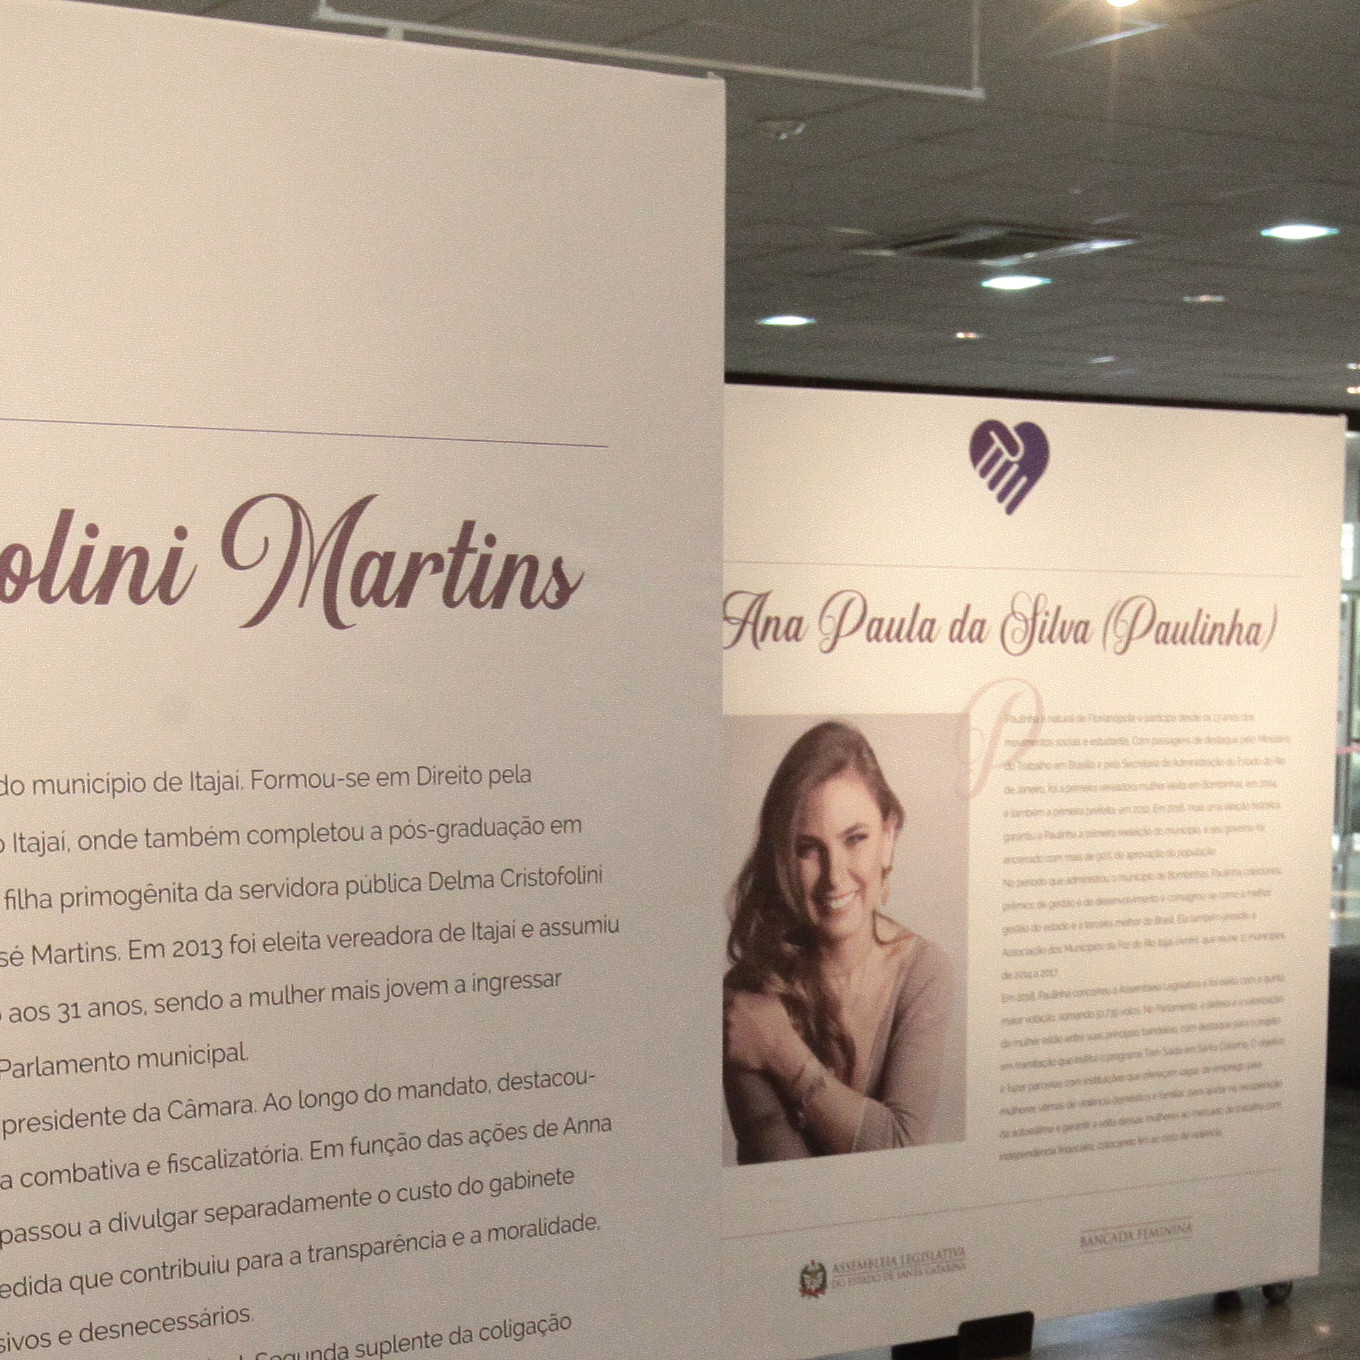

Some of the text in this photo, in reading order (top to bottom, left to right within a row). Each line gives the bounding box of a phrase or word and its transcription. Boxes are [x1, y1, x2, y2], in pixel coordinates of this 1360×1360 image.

[219, 492, 586, 631] Martins
[723, 589, 1279, 657] Ana Paula da Silva (Paulinha)
[31, 772, 147, 800] município
[151, 769, 183, 793] de
[188, 769, 245, 797] Itajaí.
[250, 767, 371, 790] Formou-se
[374, 769, 410, 787] em
[415, 764, 483, 787] Direito
[487, 763, 532, 789] pela
[2, 886, 53, 911] filha
[58, 881, 198, 914] primogênita
[203, 878, 233, 902] da
[238, 875, 339, 901] servidora
[344, 871, 422, 901] pública
[427, 868, 495, 893] Delma
[499, 863, 603, 889] Cristofolini
[7, 1003, 51, 1024] aos
[56, 1000, 81, 1025] 31
[86, 997, 148, 1019] anos,
[153, 988, 224, 1014] sendo
[228, 991, 243, 1009] a
[247, 982, 326, 1008] mulher
[330, 978, 381, 1002] mais
[382, 977, 449, 1004] jovem
[452, 977, 467, 995] a
[470, 970, 562, 997] ingressar
[130, 1100, 162, 1125] da
[166, 1096, 258, 1121] Câmara.
[261, 1091, 293, 1113] Ao
[297, 1087, 359, 1112] longo
[362, 1081, 392, 1104] do
[396, 1074, 492, 1101] mandato,
[495, 1068, 596, 1093] destacou-
[87, 1218, 102, 1236] a
[106, 1206, 199, 1234] divulgar
[202, 1187, 373, 1226] separadamente
[376, 1187, 392, 1206] o
[394, 1178, 453, 1204] custo
[456, 1174, 485, 1197] do
[487, 1166, 575, 1198] gabinete
[56, 1328, 73, 1347] e
[77, 1306, 255, 1344] desnecessários.
